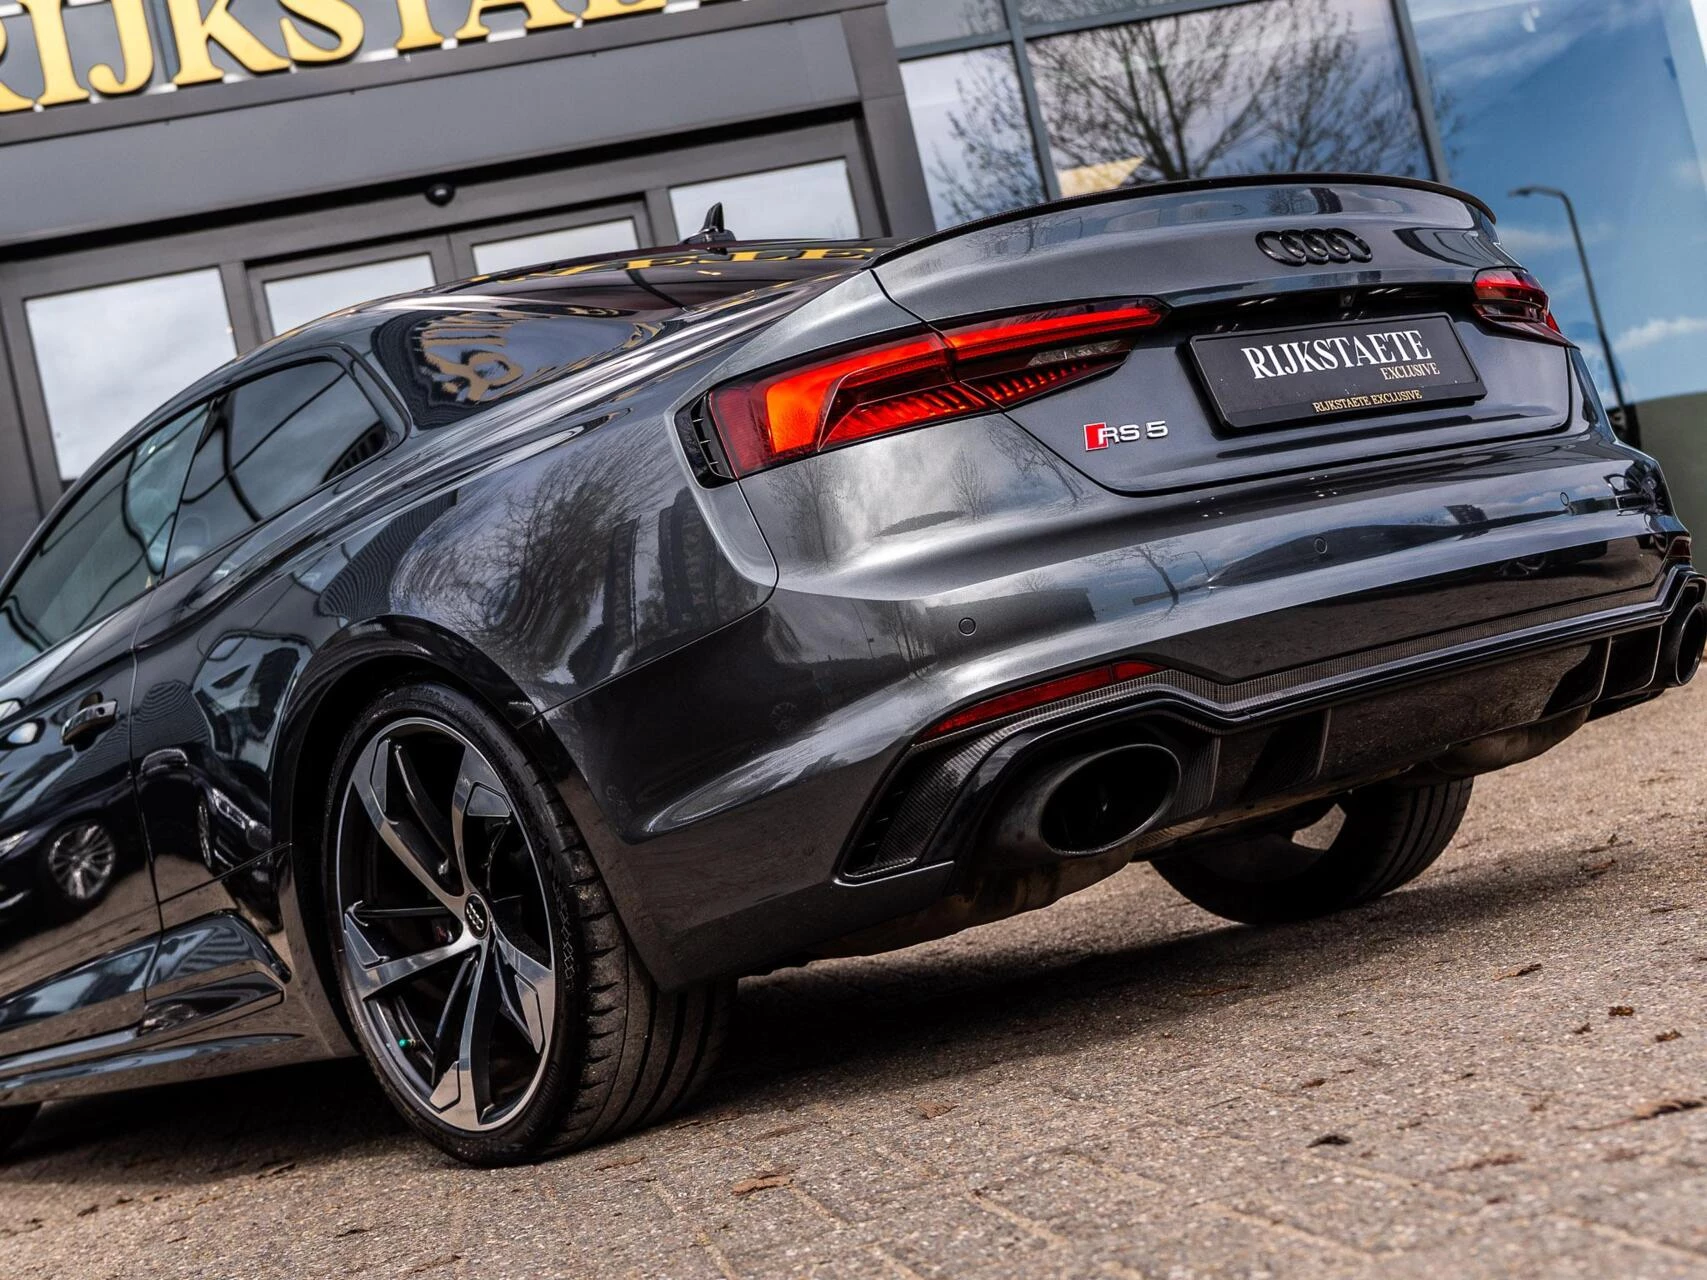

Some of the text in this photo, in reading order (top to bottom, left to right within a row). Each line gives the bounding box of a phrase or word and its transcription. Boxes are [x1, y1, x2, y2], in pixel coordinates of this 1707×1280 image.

[1241, 330, 1432, 379] RIJKSTAETE
[1380, 362, 1440, 380] EXCLUSIVE
[1312, 389, 1423, 413] RIJKSTAETE EXCLUSIVE
[1145, 420, 1169, 438] 5
